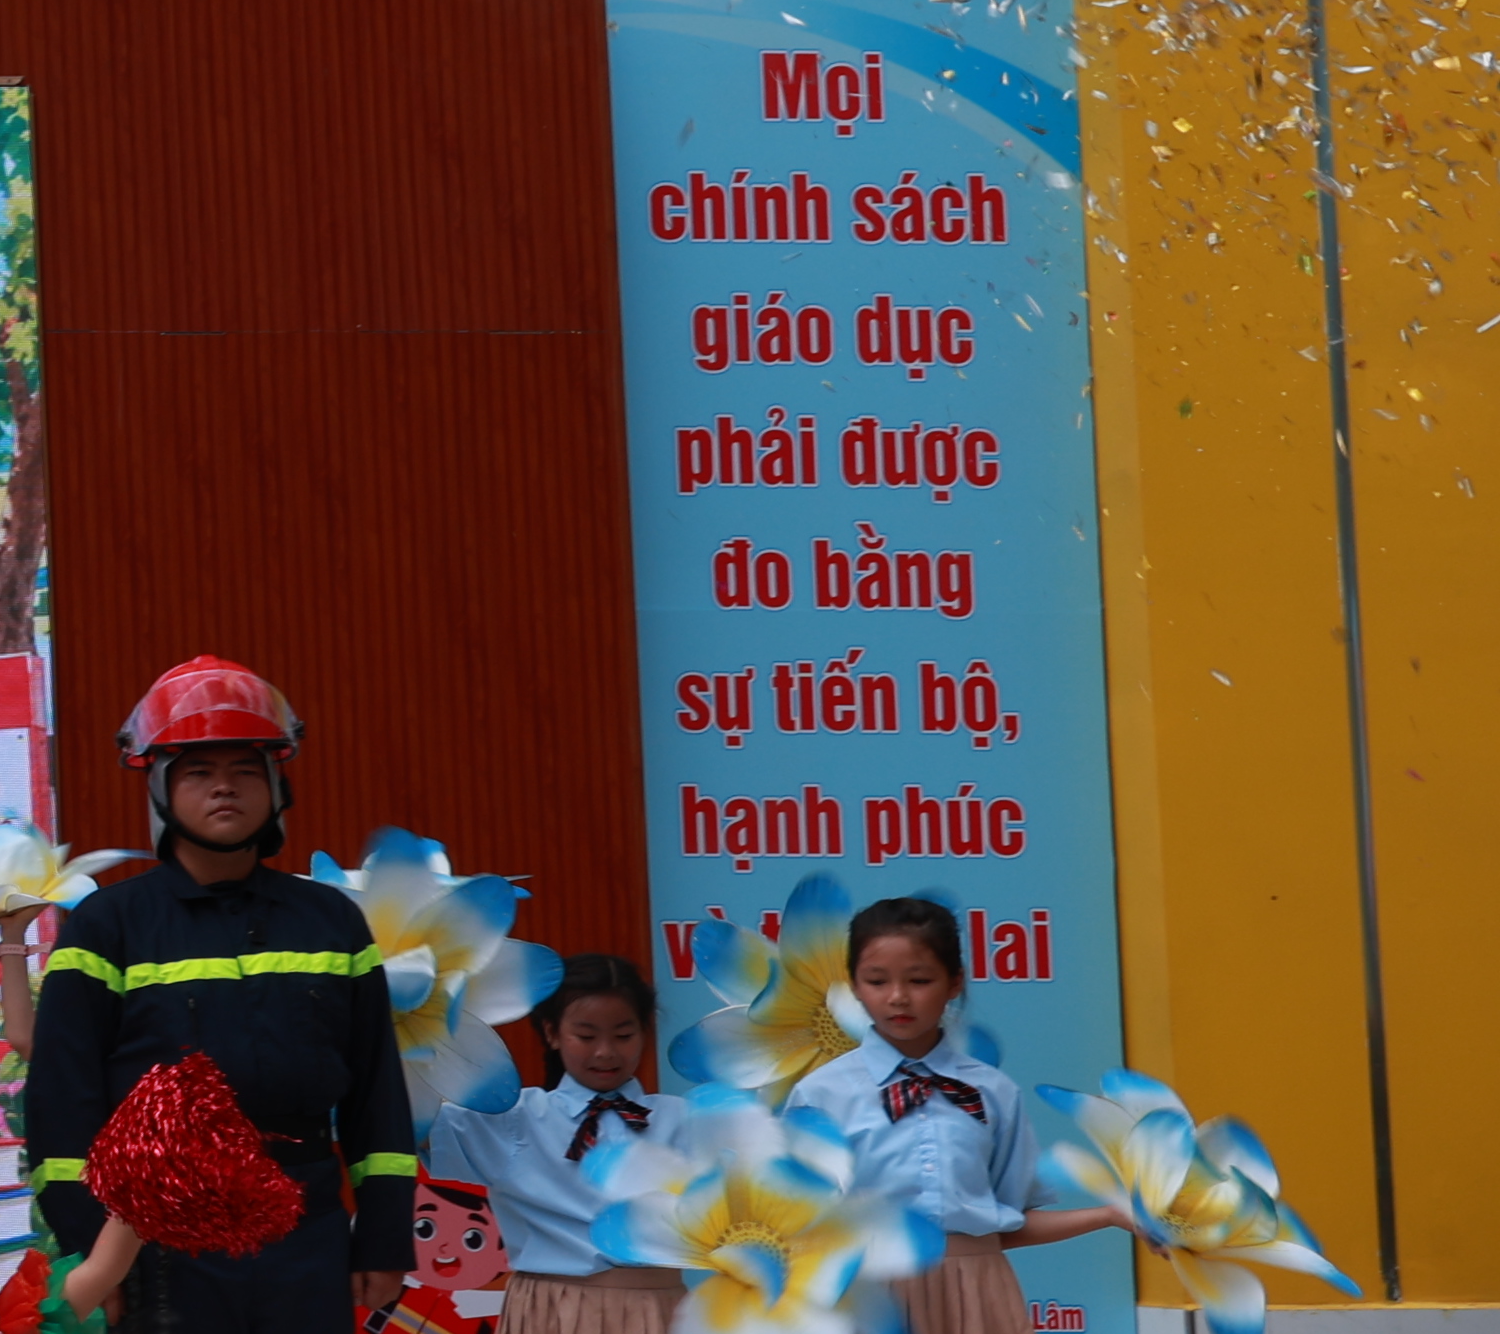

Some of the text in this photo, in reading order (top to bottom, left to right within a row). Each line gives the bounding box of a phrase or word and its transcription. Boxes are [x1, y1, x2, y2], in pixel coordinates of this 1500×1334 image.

[759, 49, 886, 138] Mọi
[647, 168, 1009, 245] chính sách
[690, 290, 975, 381] giáo dục
[675, 647, 1022, 750] sự tiến bộ,
[678, 782, 1027, 873] hạnh phúc
[967, 908, 1054, 981] lai
[1031, 1299, 1087, 1334] Lâm
